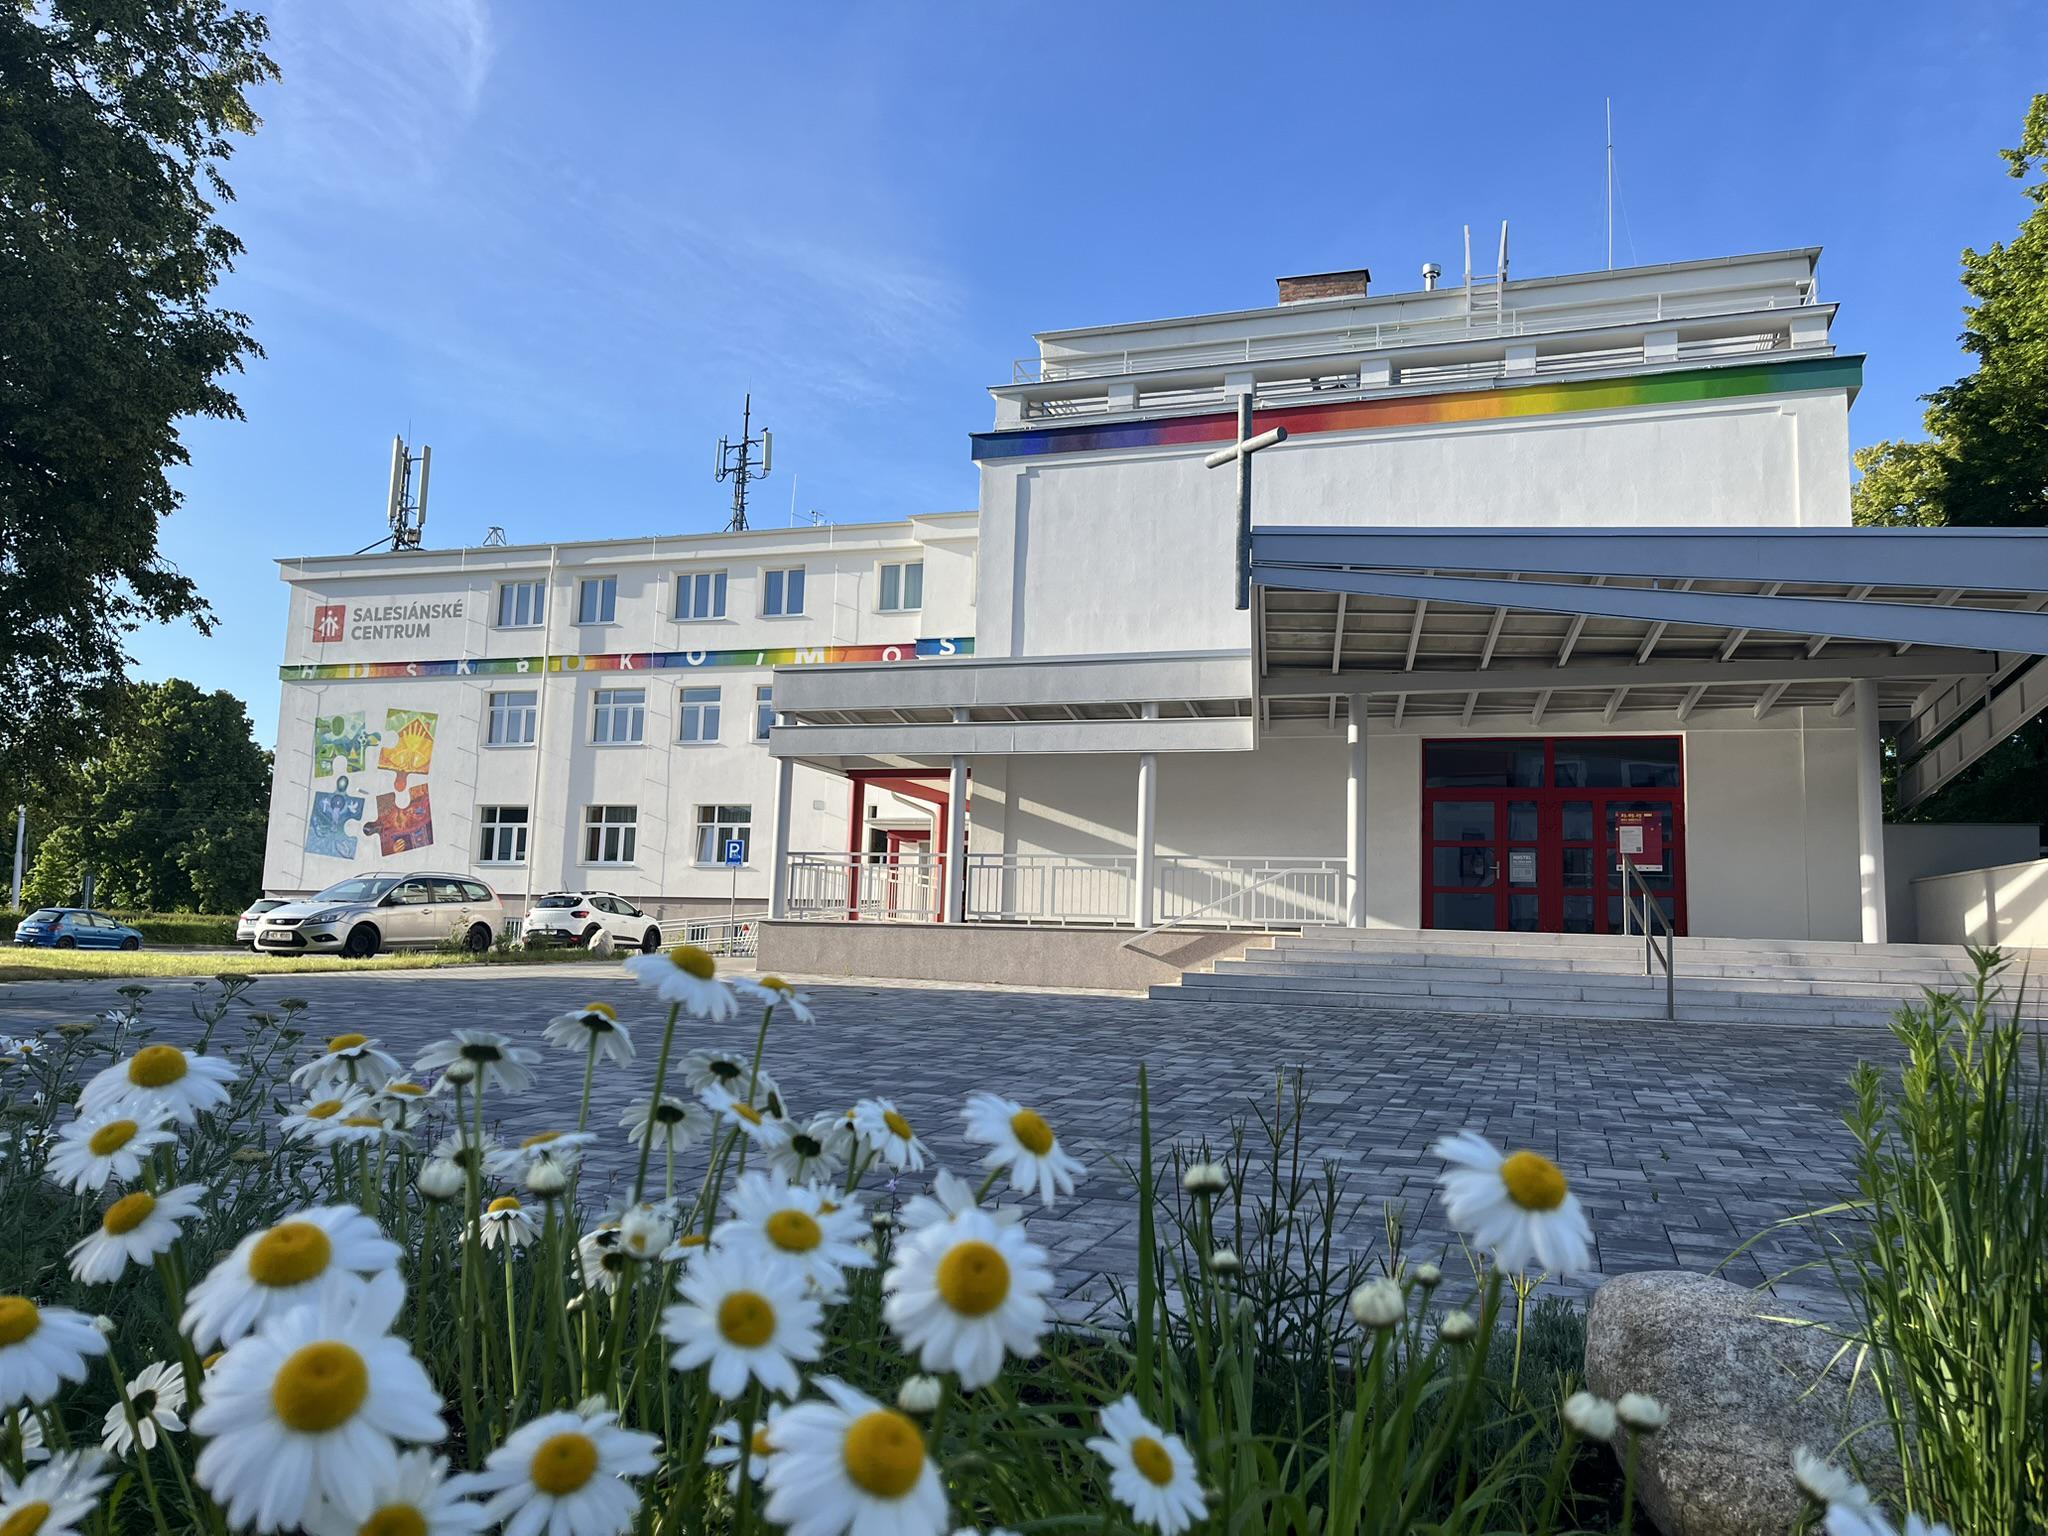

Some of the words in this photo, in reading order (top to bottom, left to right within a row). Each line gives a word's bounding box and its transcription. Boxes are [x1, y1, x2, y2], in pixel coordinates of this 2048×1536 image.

[353, 599, 463, 622] SALESIÁNSKÉ
[351, 624, 431, 641] CENTRUM
[729, 843, 740, 858] P
